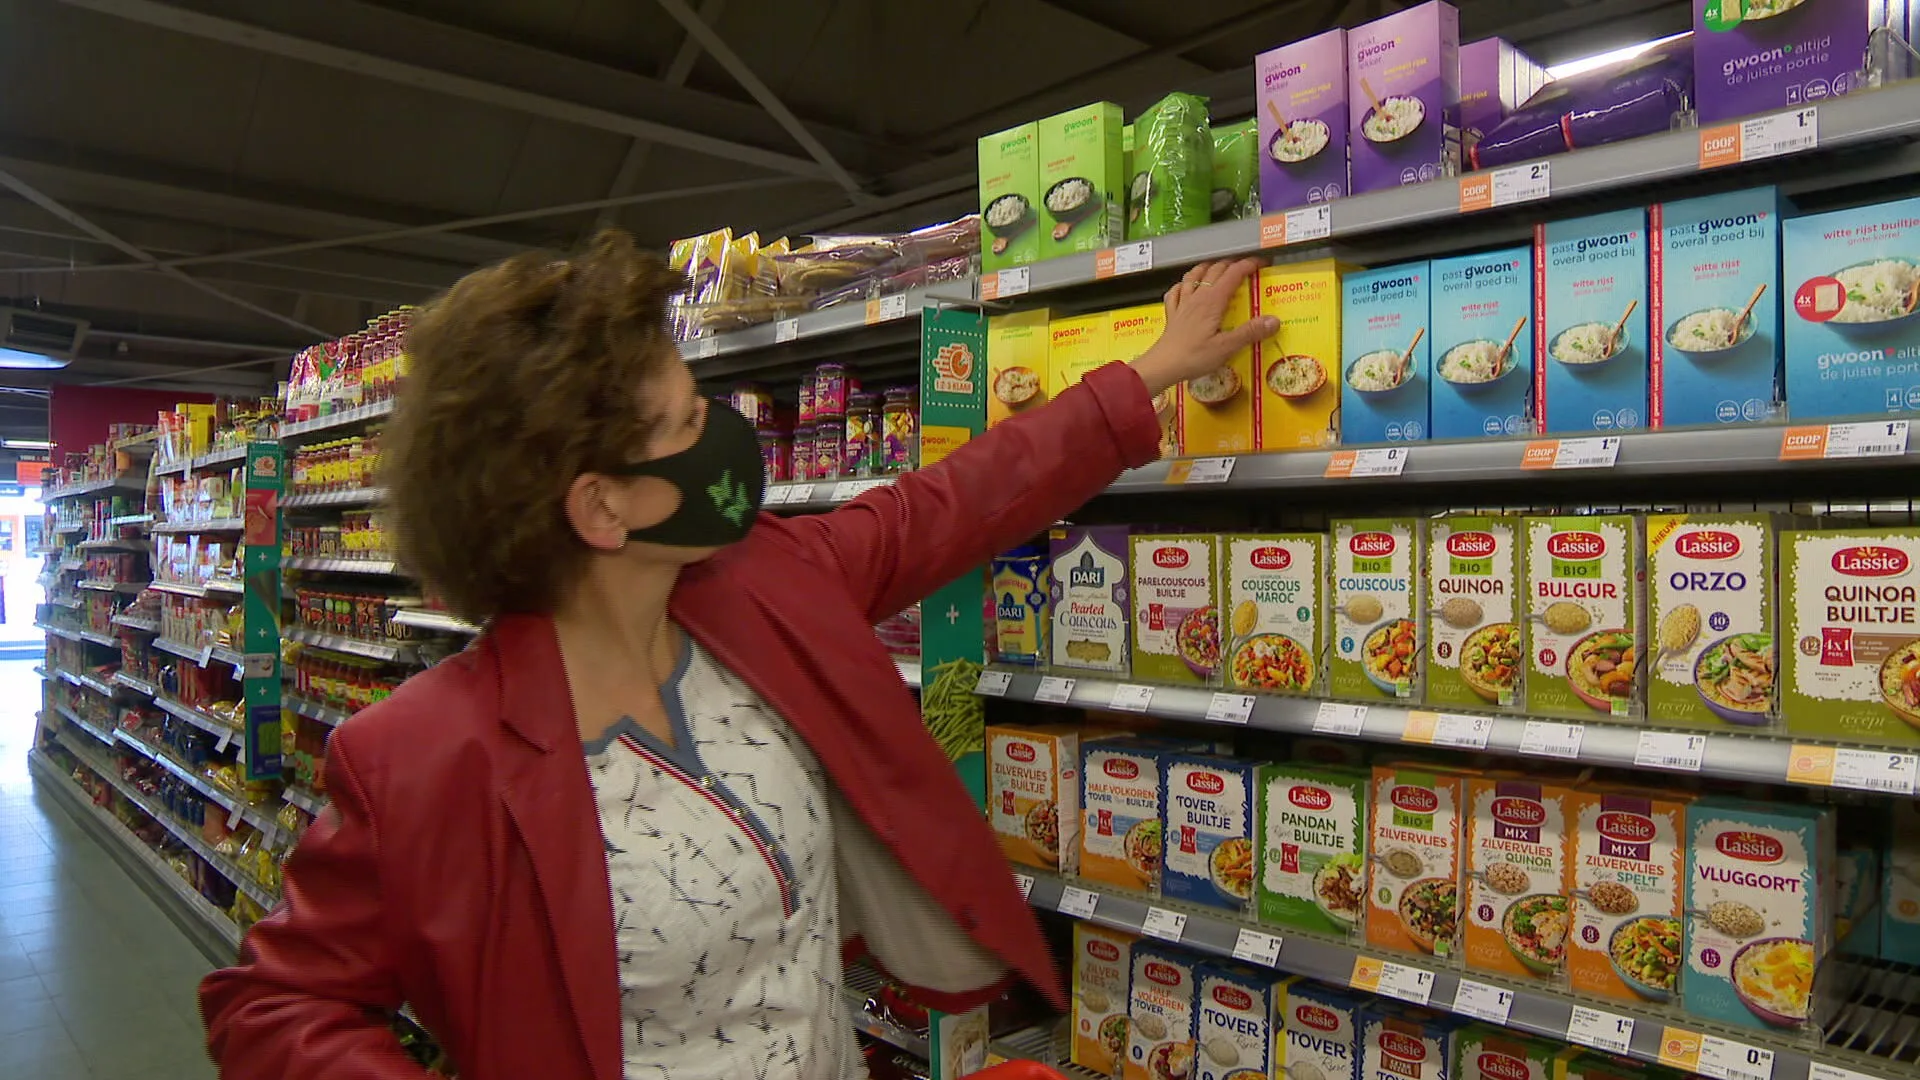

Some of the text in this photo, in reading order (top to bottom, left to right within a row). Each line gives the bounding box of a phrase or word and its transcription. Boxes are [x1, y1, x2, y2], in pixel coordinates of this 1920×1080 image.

[1357, 40, 1396, 62] gwoon
[1723, 36, 1831, 76] gwoon altijd
[1265, 64, 1301, 86] gwoon
[1726, 51, 1830, 86] de juiste portie
[1064, 117, 1093, 133] gwoon
[1000, 137, 1028, 151] gwoon
[1704, 136, 1736, 151] COOP
[1462, 184, 1487, 197] COOP
[1263, 223, 1283, 235] COOP
[1670, 213, 1757, 237] past gwoon
[1824, 224, 1877, 240] witte rijst
[1551, 232, 1629, 254] past gwoon
[1671, 228, 1765, 249] overal goed bij
[1553, 247, 1635, 266] overal goed bij
[1442, 262, 1512, 282] past gwoon
[1693, 260, 1740, 272] witte rijst
[1265, 281, 1304, 297] gwoon
[1351, 277, 1413, 295] past gwoon
[1443, 275, 1518, 292] overal goed bij
[1573, 276, 1614, 288] witte rijst
[1270, 291, 1321, 307] goede basis
[1352, 288, 1418, 305] overal goed bij
[1797, 294, 1811, 305] 4x
[1461, 302, 1482, 312] witte
[1113, 316, 1144, 332] gwoon
[1053, 327, 1080, 342] gwoon
[1817, 346, 1920, 369] gwoon alti
[1821, 361, 1920, 381] de juiste port
[1890, 393, 1897, 403] 4
[921, 436, 946, 446] gwoon
[1787, 434, 1821, 446] COOP
[1527, 448, 1554, 457] COOP
[1652, 519, 1678, 546] NIEUW
[1354, 538, 1390, 552] Lassie
[1452, 538, 1490, 552] Lassie
[1553, 540, 1599, 554] Lassie
[1682, 539, 1735, 554] Lassie
[1156, 551, 1186, 564] Lassie
[1254, 551, 1287, 565] Lassie
[1839, 553, 1900, 570] Lassie
[1362, 562, 1381, 571] BIO
[1459, 563, 1480, 573] BIO
[1563, 566, 1587, 576] BIO
[1072, 571, 1101, 584] DARI
[1138, 577, 1205, 588] PARELCOUSCOUS
[1339, 578, 1406, 591] COUSCOUS
[1670, 572, 1747, 591] ORZO
[1156, 588, 1186, 598] BUILTJE
[1242, 580, 1300, 592] COUSCOUS
[1439, 579, 1503, 595] QUINOA
[1538, 582, 1617, 599] BULGUR
[1825, 586, 1916, 602] QUINOA
[1255, 592, 1294, 603] MAROC
[999, 607, 1022, 618] DARI
[1071, 603, 1105, 615] Pearled
[1827, 606, 1915, 623] BUILTJE
[1714, 616, 1726, 626] 10
[1804, 640, 1819, 650] 12
[1824, 639, 1849, 651] 4x1
[1657, 701, 1696, 715] recept
[1839, 713, 1885, 730] recept
[1008, 748, 1033, 759] Lassie
[995, 763, 1048, 782] ZILVERVLIES
[1106, 763, 1135, 776] Lassie
[1011, 779, 1046, 795] BUILTJE
[1189, 775, 1221, 791] Lassie
[1088, 792, 1155, 809] TOVER BUILTJE
[1176, 795, 1216, 813] TOVER
[1292, 790, 1328, 806] Lassie
[1395, 791, 1433, 808] Lassie
[1497, 804, 1540, 820] Lassie
[1187, 812, 1231, 829] BUILTJE
[1281, 812, 1337, 831] PANDAN
[1402, 817, 1423, 827] BIO
[1603, 820, 1650, 837] Lassie
[1294, 829, 1345, 849] BUILTJE
[1380, 827, 1447, 848] ZILVERVLIES
[1504, 828, 1528, 840] MIX
[1481, 838, 1553, 857] ZILVERVLIES
[1611, 844, 1637, 856] MIX
[1722, 837, 1776, 857] Lassie
[1505, 853, 1552, 867] QUINOA
[1586, 855, 1665, 876] ZILVERVLIES
[1617, 872, 1659, 887] SPELT
[1699, 864, 1801, 893] VLUGGORT
[1089, 944, 1117, 959] Lassie
[1080, 972, 1106, 987] VLIES
[1086, 963, 1120, 981] ZILVER
[1147, 965, 1178, 982] Lassie
[1150, 986, 1172, 998] HALF
[1216, 988, 1250, 1007] Lassie
[1135, 999, 1163, 1015] TOVER
[1138, 992, 1185, 1012] VOLKOREN
[1203, 1008, 1259, 1037] TOVER
[1300, 1011, 1335, 1029] Lassie
[1287, 1029, 1347, 1059] TOVER
[1383, 1036, 1421, 1056] Lassie
[1482, 1058, 1524, 1078] Lassie
